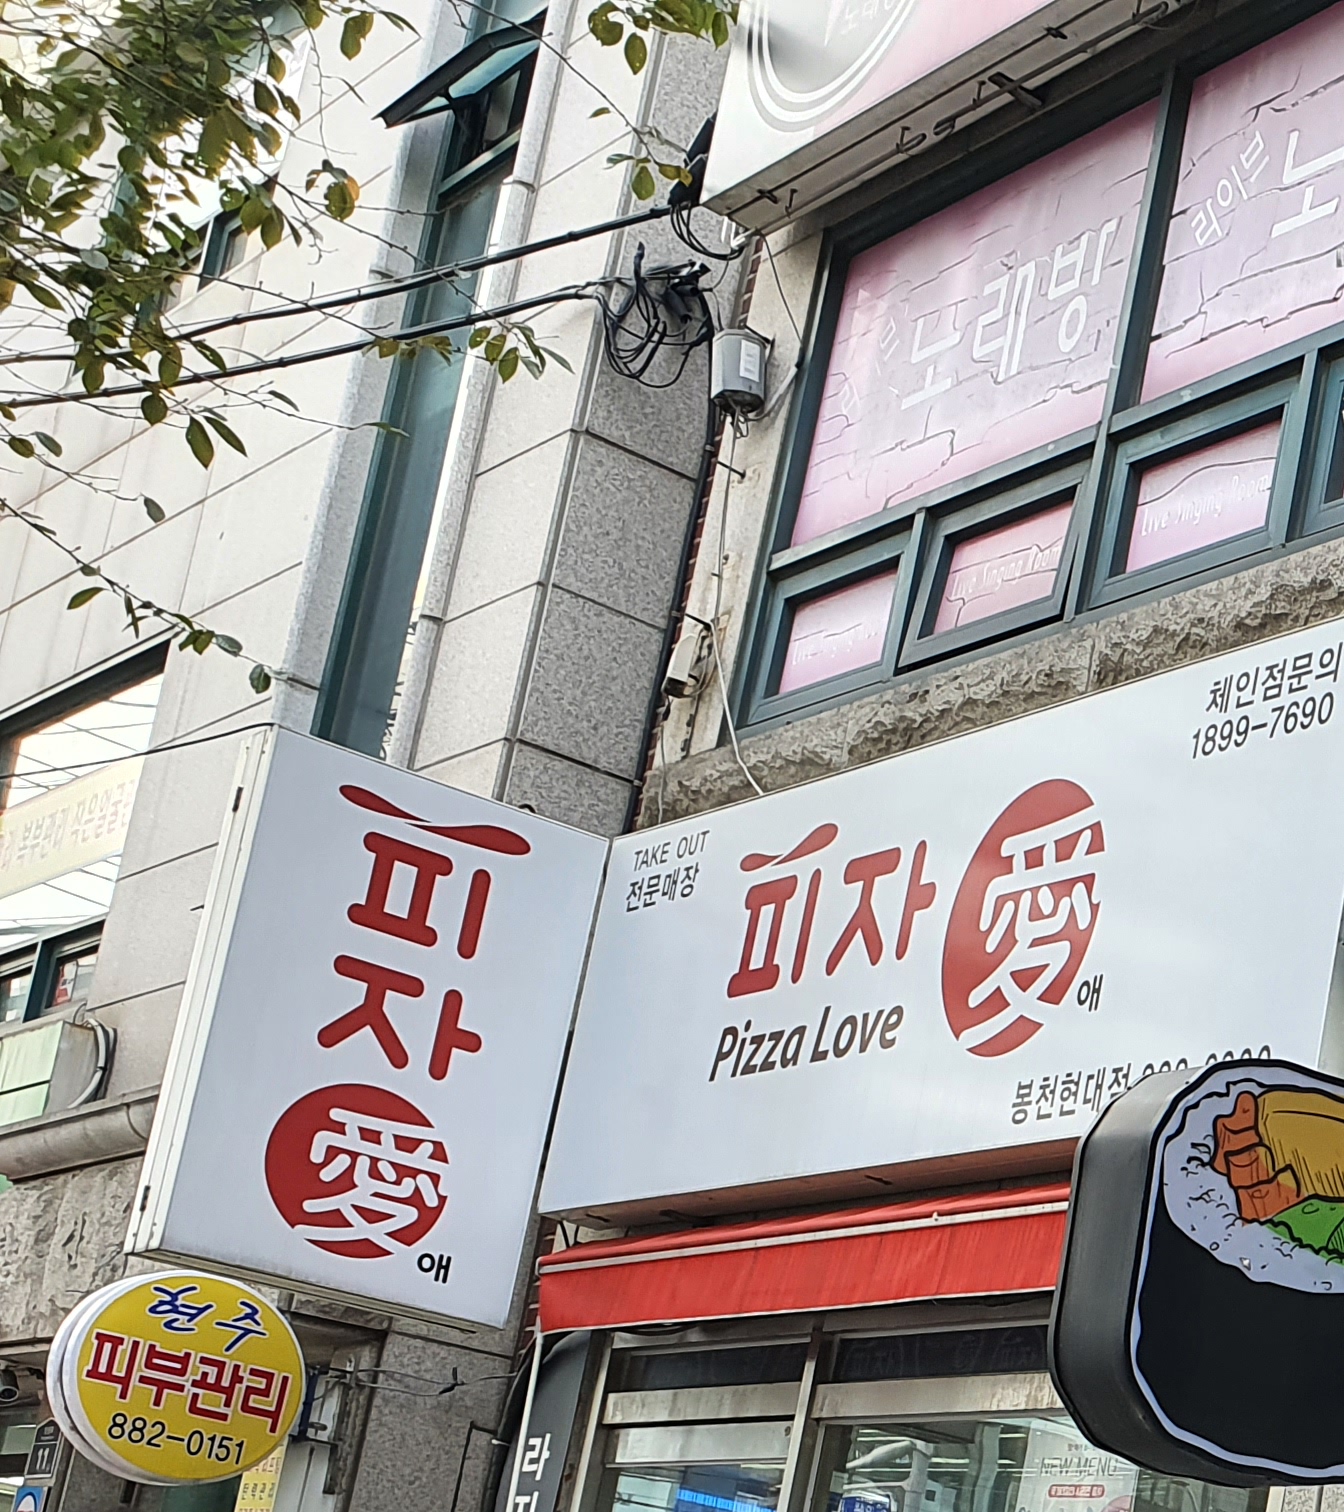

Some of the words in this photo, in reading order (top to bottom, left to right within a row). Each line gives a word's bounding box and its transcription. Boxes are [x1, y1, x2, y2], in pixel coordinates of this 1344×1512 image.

[1191, 131, 1272, 246] 라이브
[902, 218, 1117, 411] 노래방
[1141, 495, 1170, 536] Live
[1174, 484, 1223, 526] Singing
[1231, 474, 1270, 504] Room
[1205, 641, 1344, 716] 체인점문의
[1189, 690, 1336, 760] 1899-7690
[633, 842, 671, 872] TAKE
[676, 829, 710, 863] OUT
[625, 863, 700, 914] 전문매장
[1076, 974, 1104, 1012] 애
[708, 1018, 804, 1082] Pizza
[808, 1003, 905, 1065] Love
[416, 1251, 453, 1284] 애
[84, 1331, 291, 1435] 피부관리
[107, 1412, 246, 1466] 882-0151
